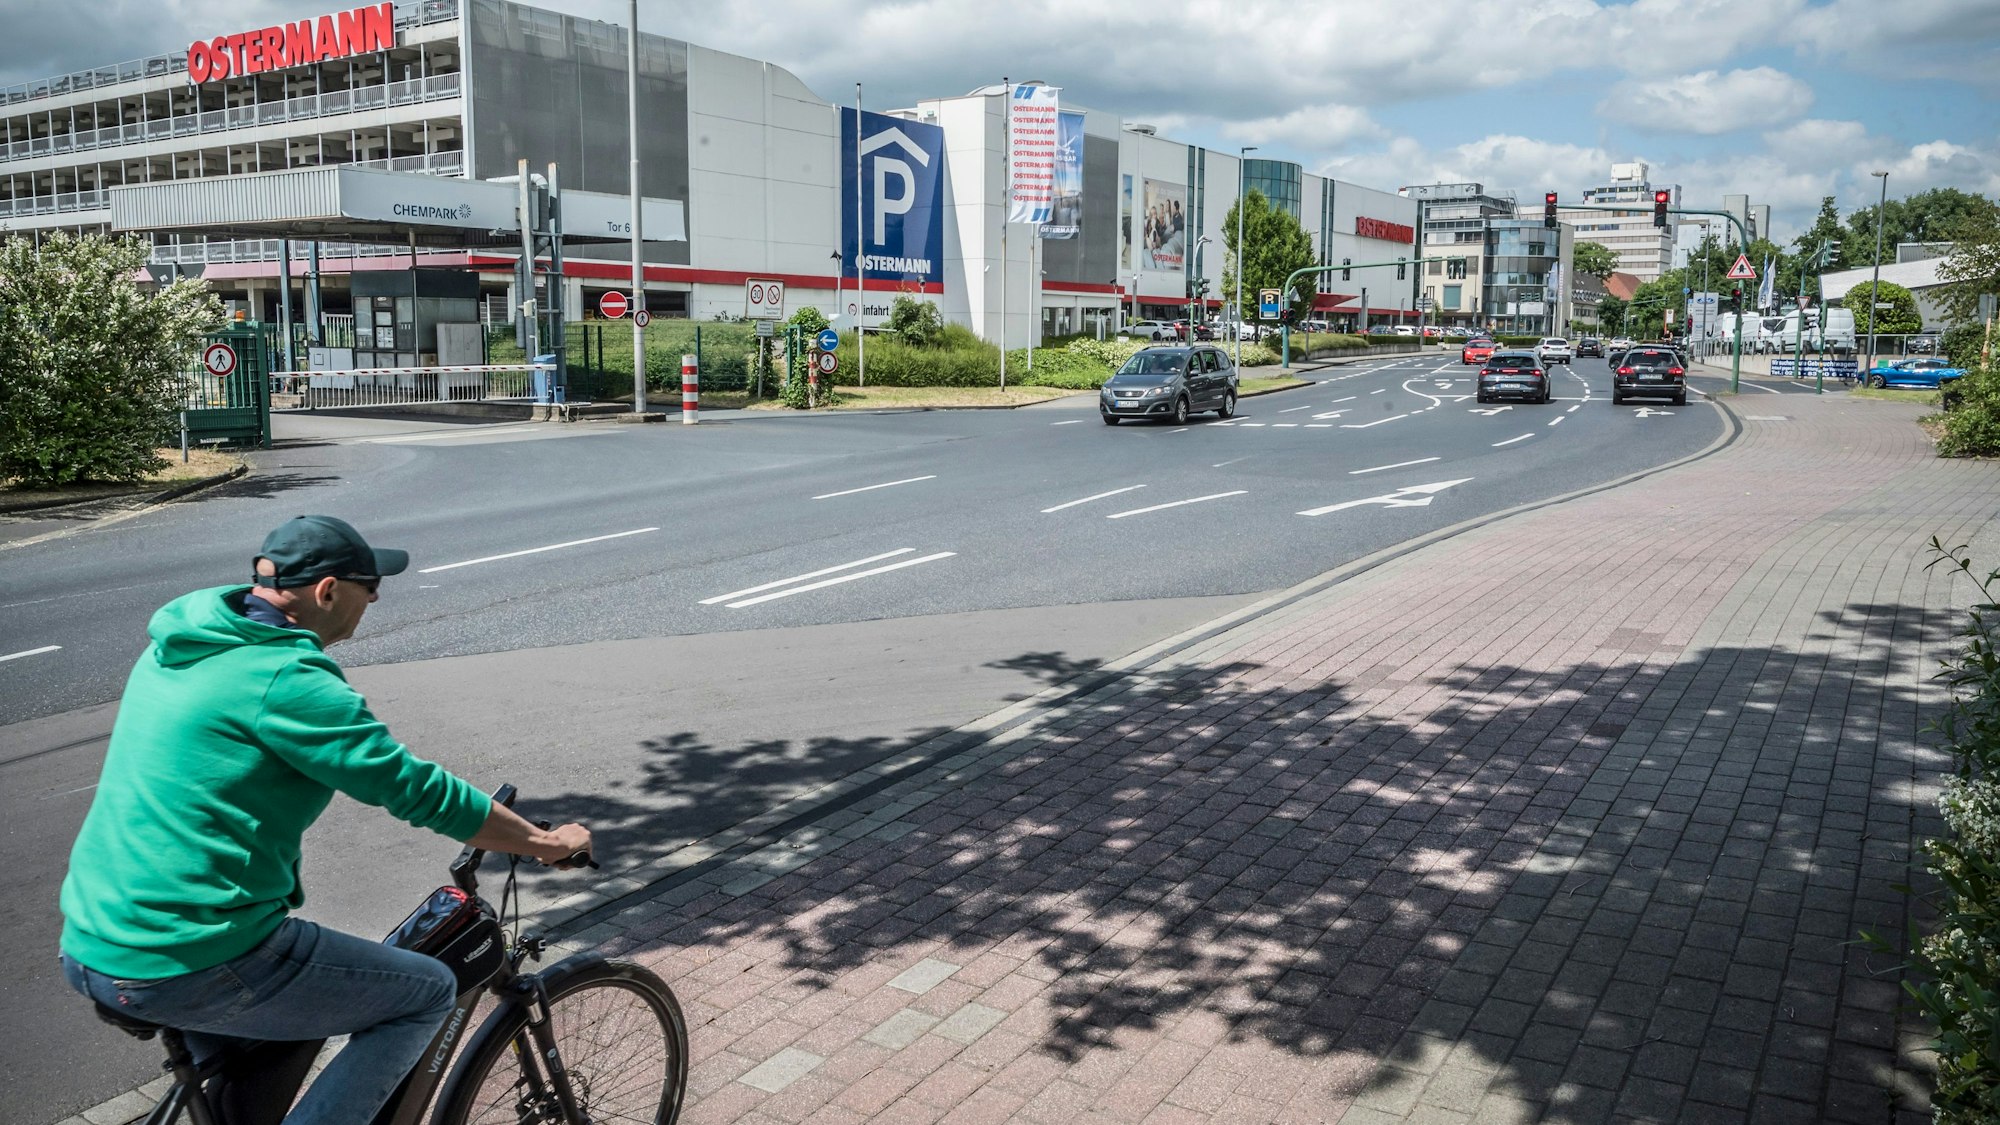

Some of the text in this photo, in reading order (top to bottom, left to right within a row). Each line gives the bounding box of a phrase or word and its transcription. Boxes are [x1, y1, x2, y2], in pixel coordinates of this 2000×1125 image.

[188, 2, 394, 84] OSTERMANN
[874, 155, 915, 246] P
[393, 203, 458, 220] CHEMPARK
[607, 221, 631, 233] Tor 6
[1358, 216, 1413, 244] OSTERMANN
[855, 255, 931, 274] OSTERMANN
[1153, 254, 1183, 263] OSTERMANN
[752, 290, 761, 299] 30
[428, 1007, 466, 1074] VICTORIA
